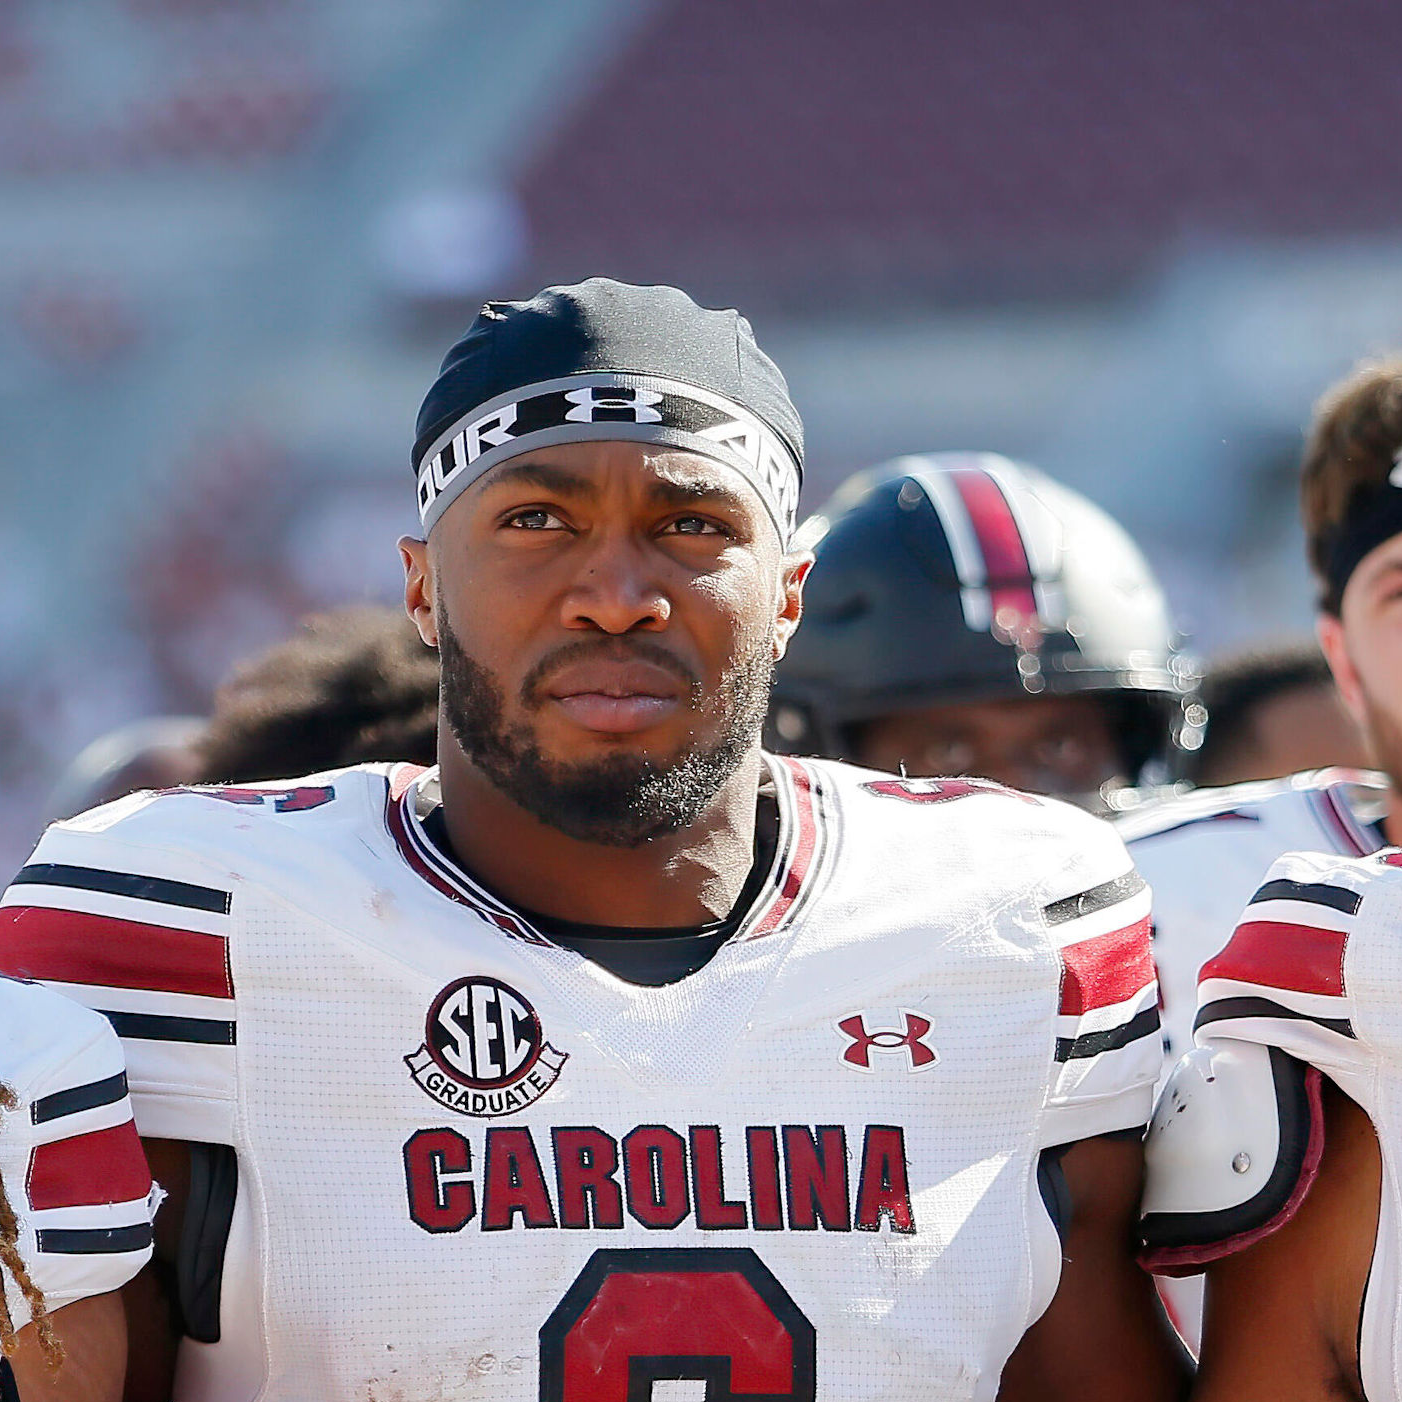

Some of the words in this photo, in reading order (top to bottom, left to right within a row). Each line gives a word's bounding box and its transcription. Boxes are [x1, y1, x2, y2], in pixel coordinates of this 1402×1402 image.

[437, 984, 532, 1080] SEC
[425, 1070, 548, 1113] GRADUATE
[402, 1122, 917, 1235] CAROLINA
